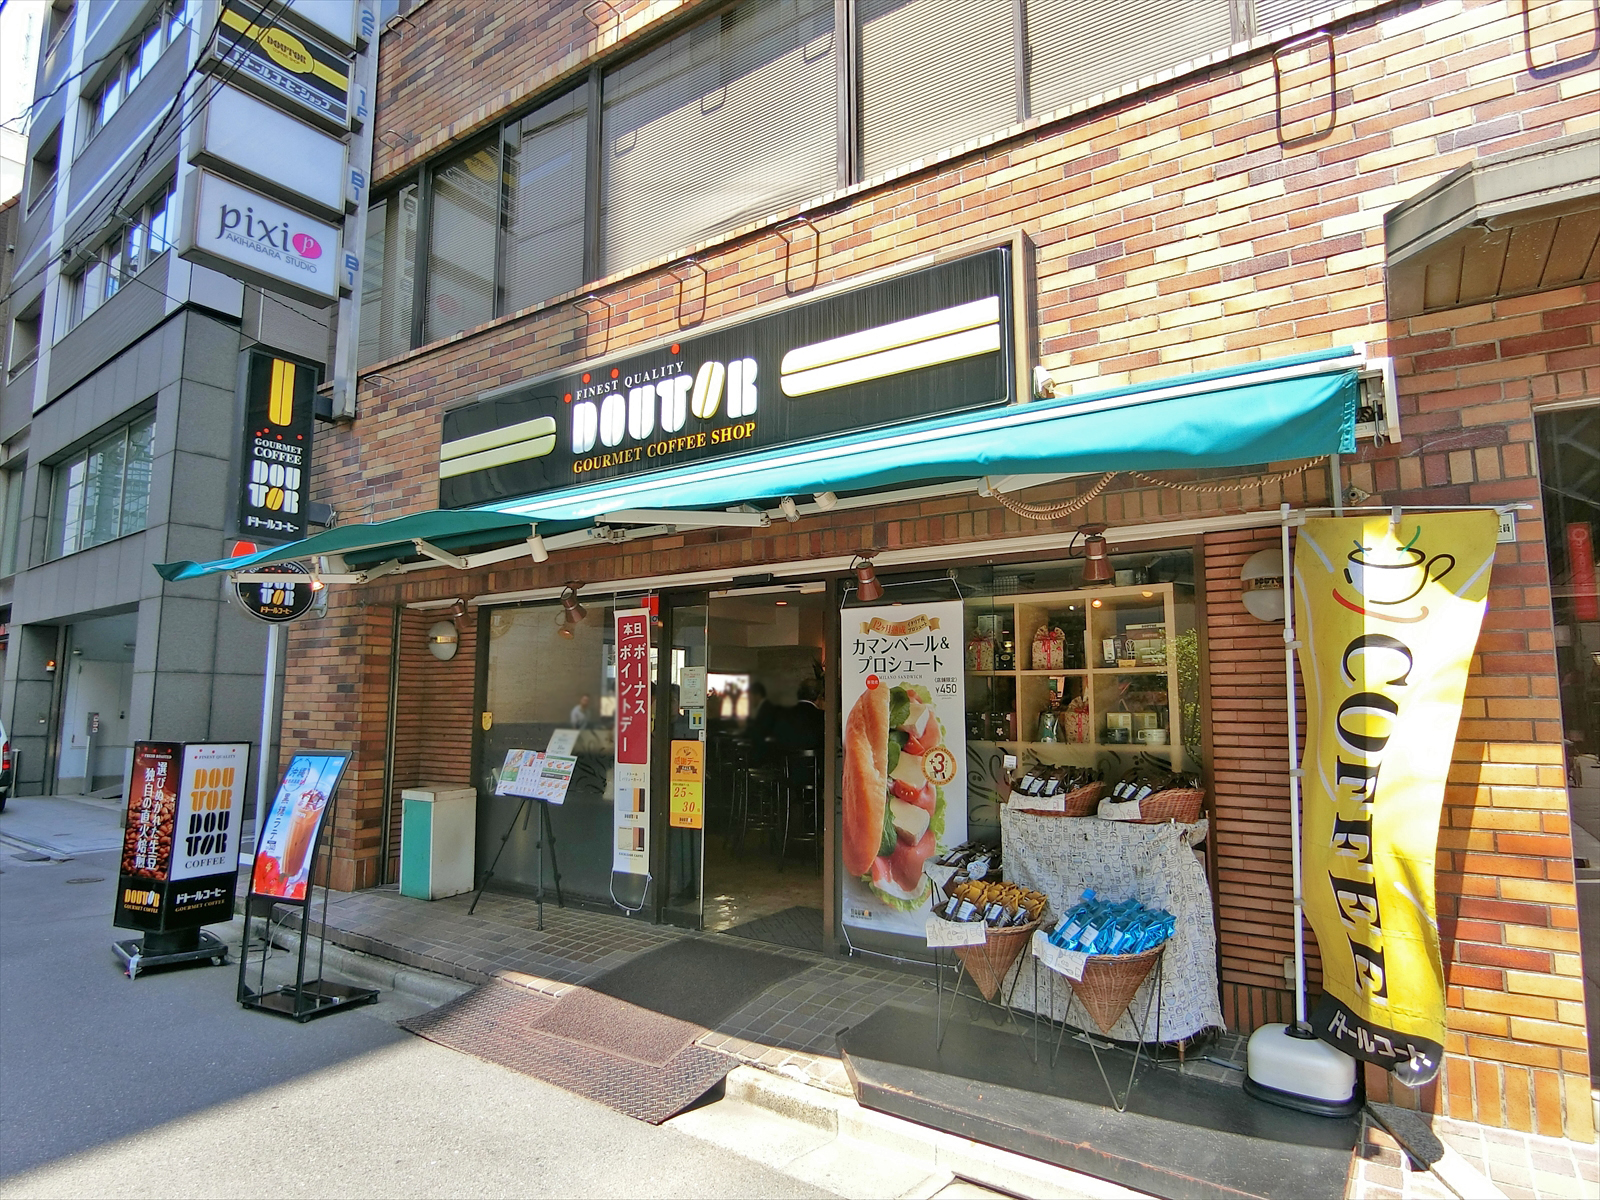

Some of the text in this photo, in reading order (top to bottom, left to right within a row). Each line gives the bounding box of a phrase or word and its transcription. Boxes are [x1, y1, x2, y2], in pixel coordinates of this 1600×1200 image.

[362, 10, 374, 37] 2F
[267, 36, 306, 65] DOUTOR
[358, 90, 368, 119] 1F
[351, 170, 366, 201] B1
[216, 204, 290, 252] pixi
[226, 232, 318, 275] AKIHABARA STUDIO
[345, 254, 360, 286] B1
[576, 361, 684, 400] FINEST QUALITY
[572, 358, 758, 455] DOUTOR
[254, 438, 302, 454] GOURMET
[254, 446, 302, 466] COFFEE
[573, 422, 756, 474] GOURMET COFFEE SHOP
[247, 516, 300, 532] ドトールコーヒー
[260, 606, 292, 614] ドトールコーヒー
[624, 622, 642, 635] 本日
[852, 636, 950, 656] カマンベール&
[634, 642, 646, 714] ボーナス
[858, 654, 944, 674] プロシュート
[620, 644, 632, 752] ポイントデー
[936, 684, 956, 694] ¥450
[135, 768, 156, 870] 独自の直火焙煎
[146, 761, 168, 870] 選びぬかれた生豆
[1328, 632, 1414, 1005] COFFEE
[185, 856, 226, 870] COFFEE
[124, 888, 160, 908] DOUTOR
[124, 904, 158, 914] GOURMET COFFEE
[174, 899, 226, 912] GOURMET COFFEE
[176, 888, 226, 904] ドトールコーヒー
[1328, 1010, 1432, 1072] ドトールコーヒー
